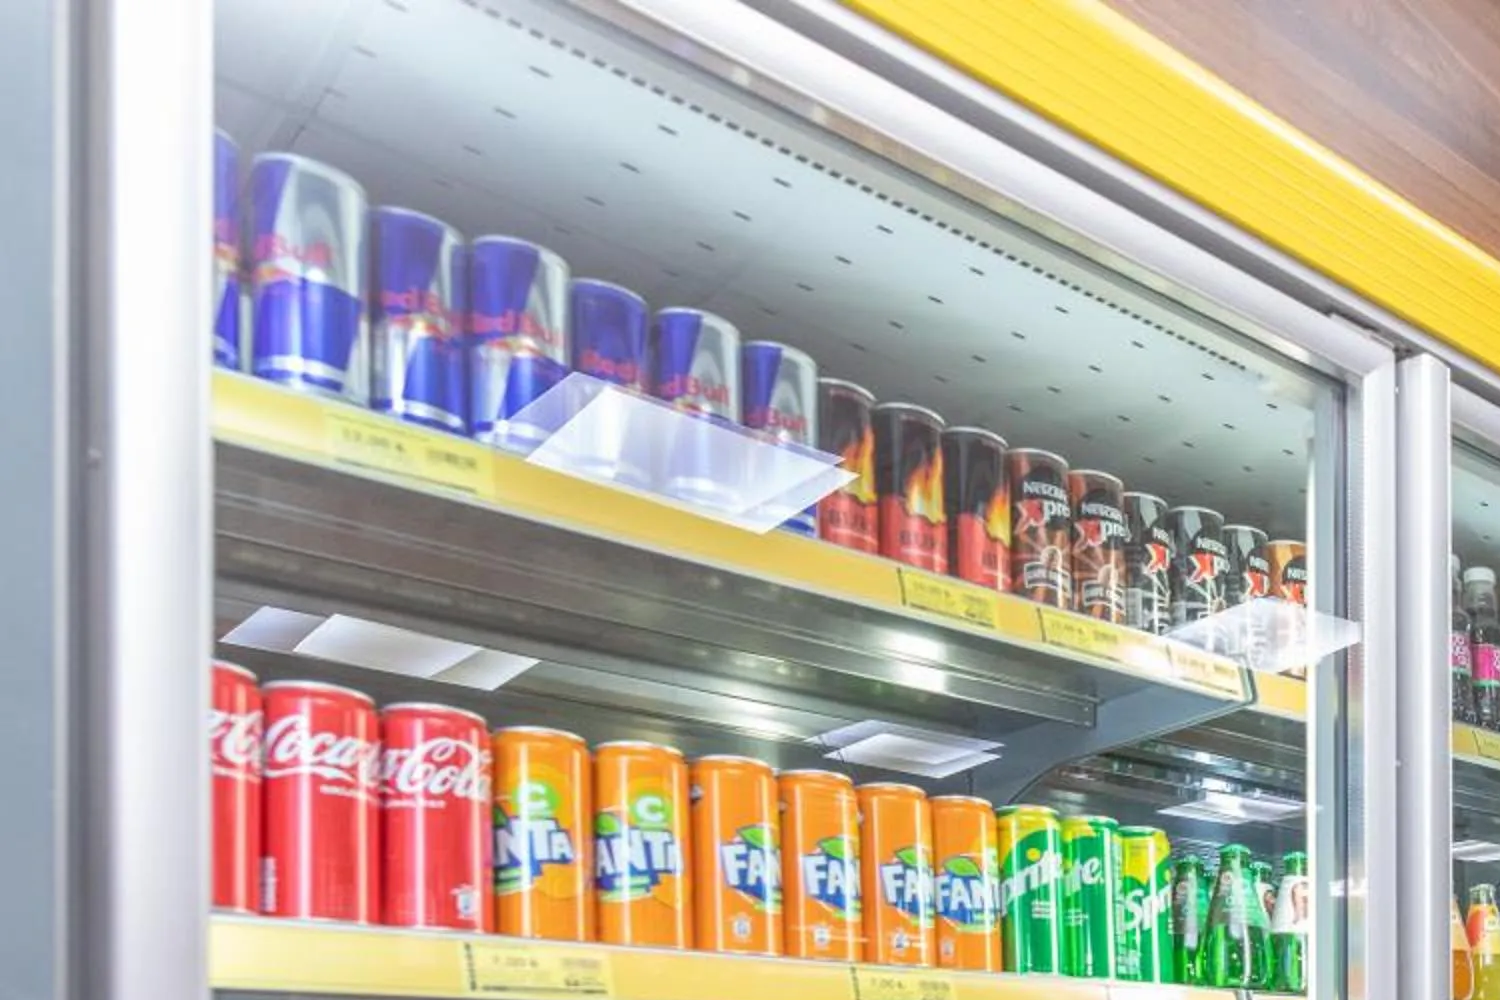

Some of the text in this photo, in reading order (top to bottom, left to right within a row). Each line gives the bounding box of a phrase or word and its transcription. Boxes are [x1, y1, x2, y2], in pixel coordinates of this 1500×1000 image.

[636, 795, 664, 822] C
[496, 815, 574, 867] NTA
[720, 840, 781, 890] FAN
[802, 851, 861, 898] FAN
[880, 861, 934, 911] FAN
